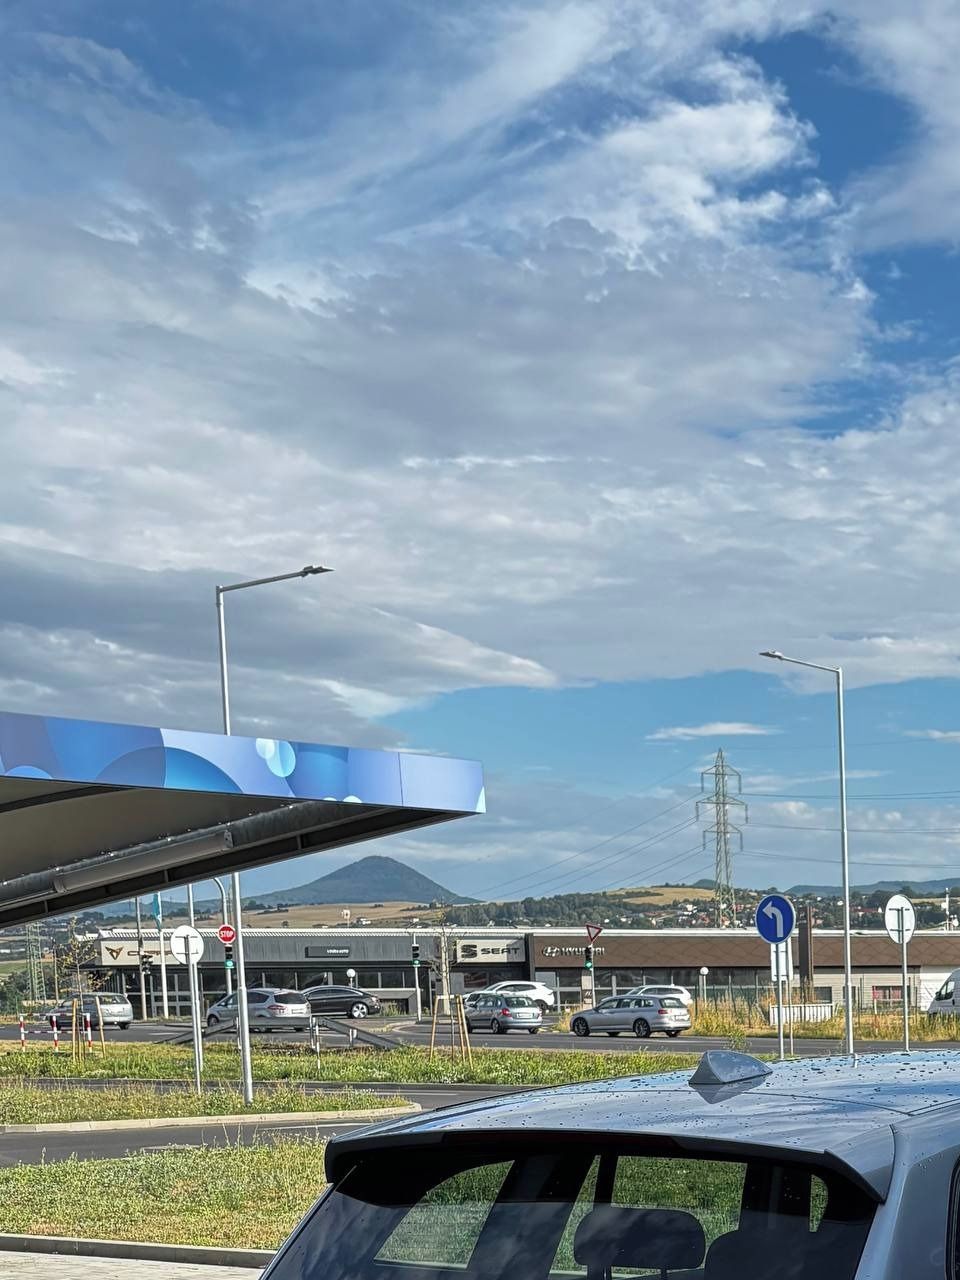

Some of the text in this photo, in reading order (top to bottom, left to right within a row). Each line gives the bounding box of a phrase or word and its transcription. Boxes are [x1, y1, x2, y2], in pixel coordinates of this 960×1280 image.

[219, 930, 234, 938] STOP
[480, 947, 520, 955] SEAT
[562, 946, 605, 955] HYUAI
